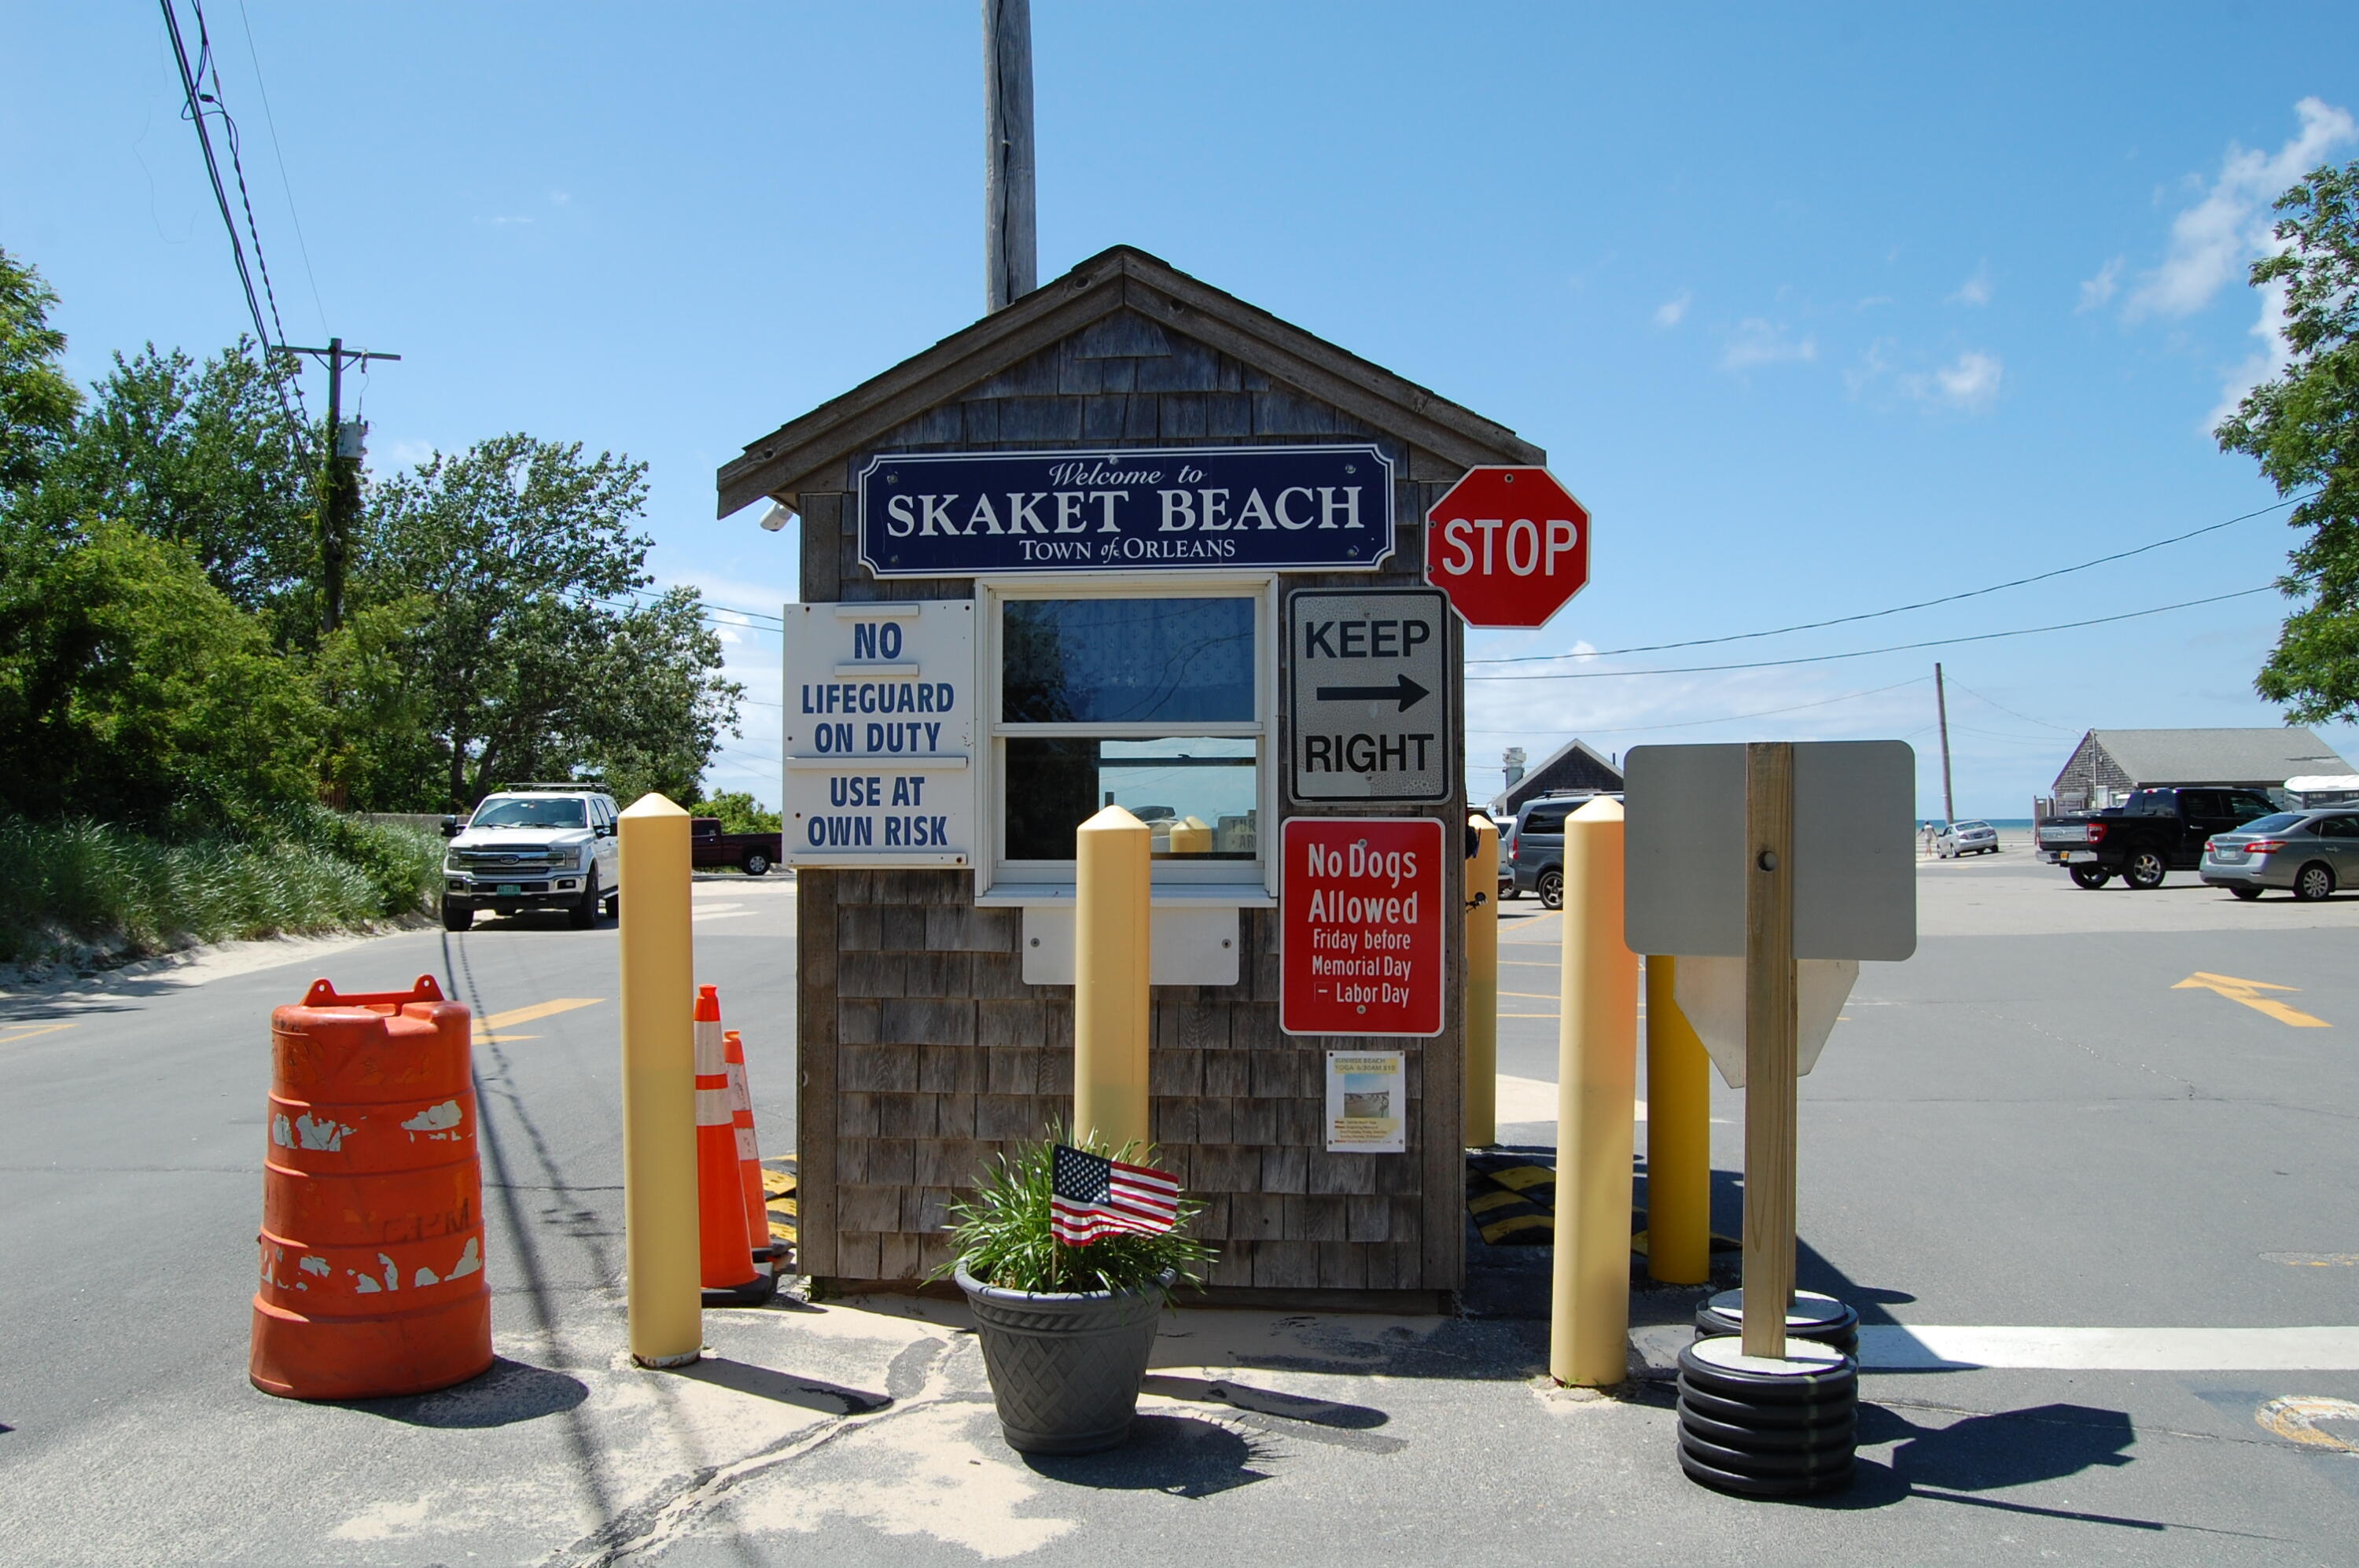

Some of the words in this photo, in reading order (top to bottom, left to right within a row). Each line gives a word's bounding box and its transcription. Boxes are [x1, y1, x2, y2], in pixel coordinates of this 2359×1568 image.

[1049, 462, 1165, 487] Welcome
[1177, 466, 1207, 484] to
[887, 491, 1129, 537] SKAKET
[1157, 487, 1364, 532] BEACH
[1443, 518, 1577, 576] STOP
[854, 622, 902, 659] NO
[1306, 620, 1430, 658] KEEP
[802, 683, 954, 714] LIFEGUARD
[815, 723, 853, 753] ON
[867, 722, 941, 752] DUTY
[1305, 734, 1434, 773] RIGHT
[830, 777, 881, 807] USE
[892, 777, 925, 806] AT
[808, 816, 872, 846] OWN
[885, 816, 948, 846] RISK
[1308, 843, 1342, 878] No
[1349, 844, 1417, 889] Dogs
[1308, 889, 1417, 923] Allowed
[1313, 929, 1357, 953] Friday
[1365, 929, 1411, 950] before
[1312, 956, 1379, 976] Memorial
[1384, 956, 1411, 981] Day
[1337, 982, 1378, 1003] Labor
[1382, 983, 1409, 1008] Day
